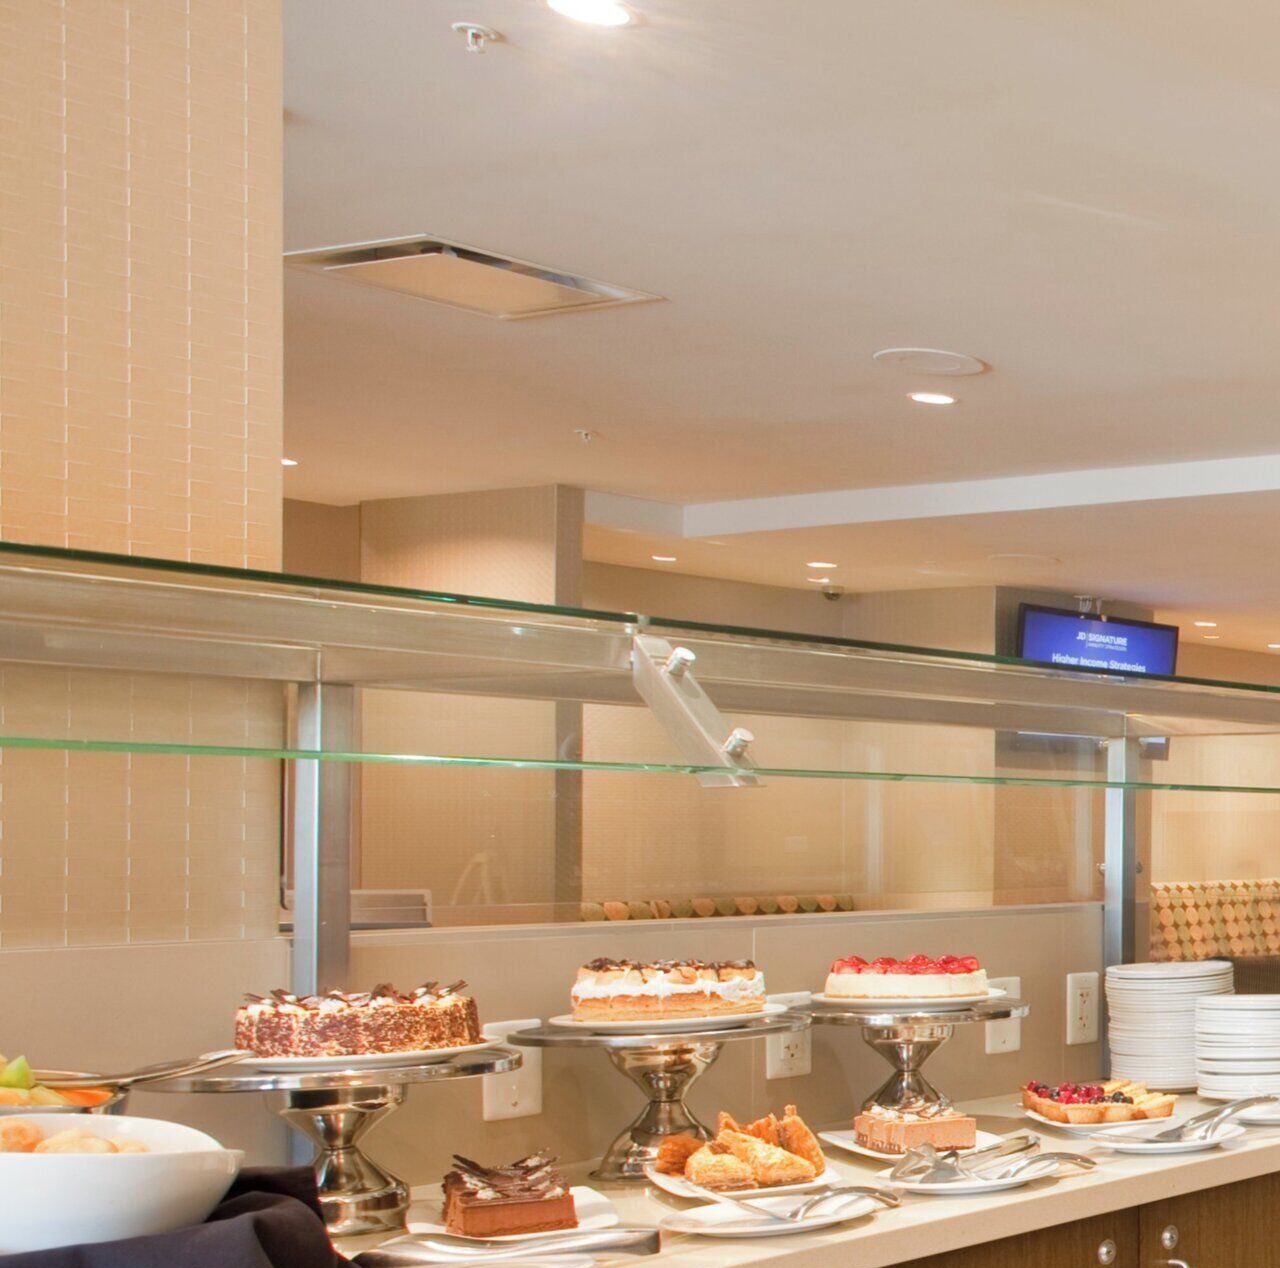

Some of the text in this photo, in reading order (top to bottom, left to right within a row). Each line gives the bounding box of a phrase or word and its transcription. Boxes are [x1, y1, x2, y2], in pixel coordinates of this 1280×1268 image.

[1088, 633, 1127, 645] SIGNATURE
[1052, 653, 1146, 672] Higher Income Strategies
